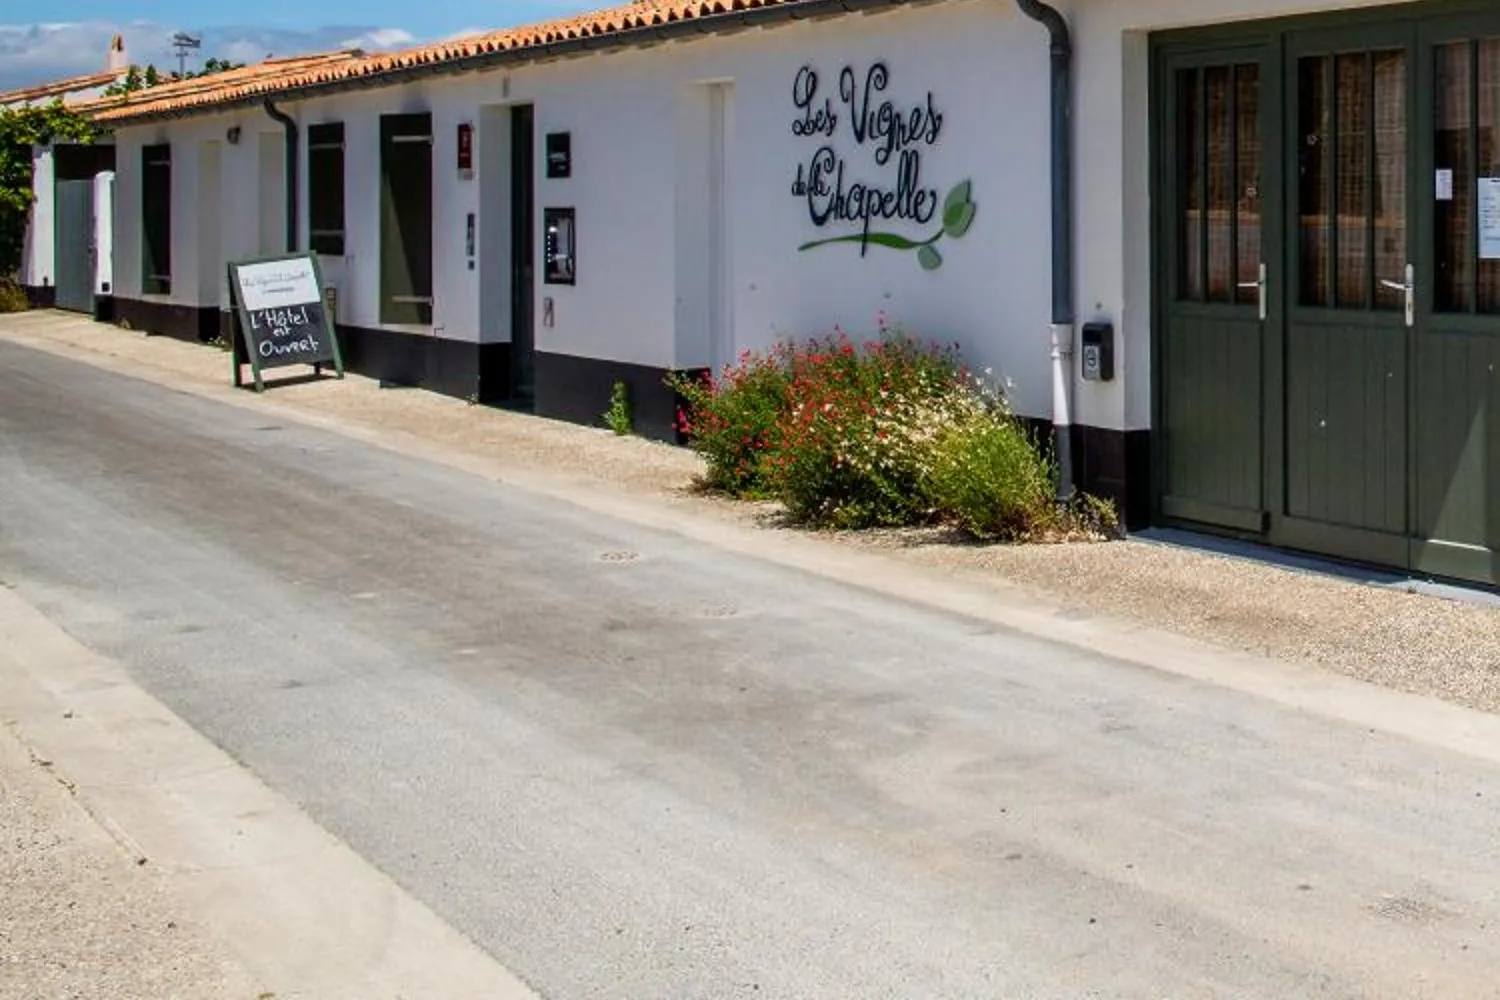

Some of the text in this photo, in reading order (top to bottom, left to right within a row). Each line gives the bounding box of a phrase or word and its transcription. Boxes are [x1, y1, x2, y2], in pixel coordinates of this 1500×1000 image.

[792, 63, 943, 165] Les Vignes
[807, 147, 937, 257] Chapelle
